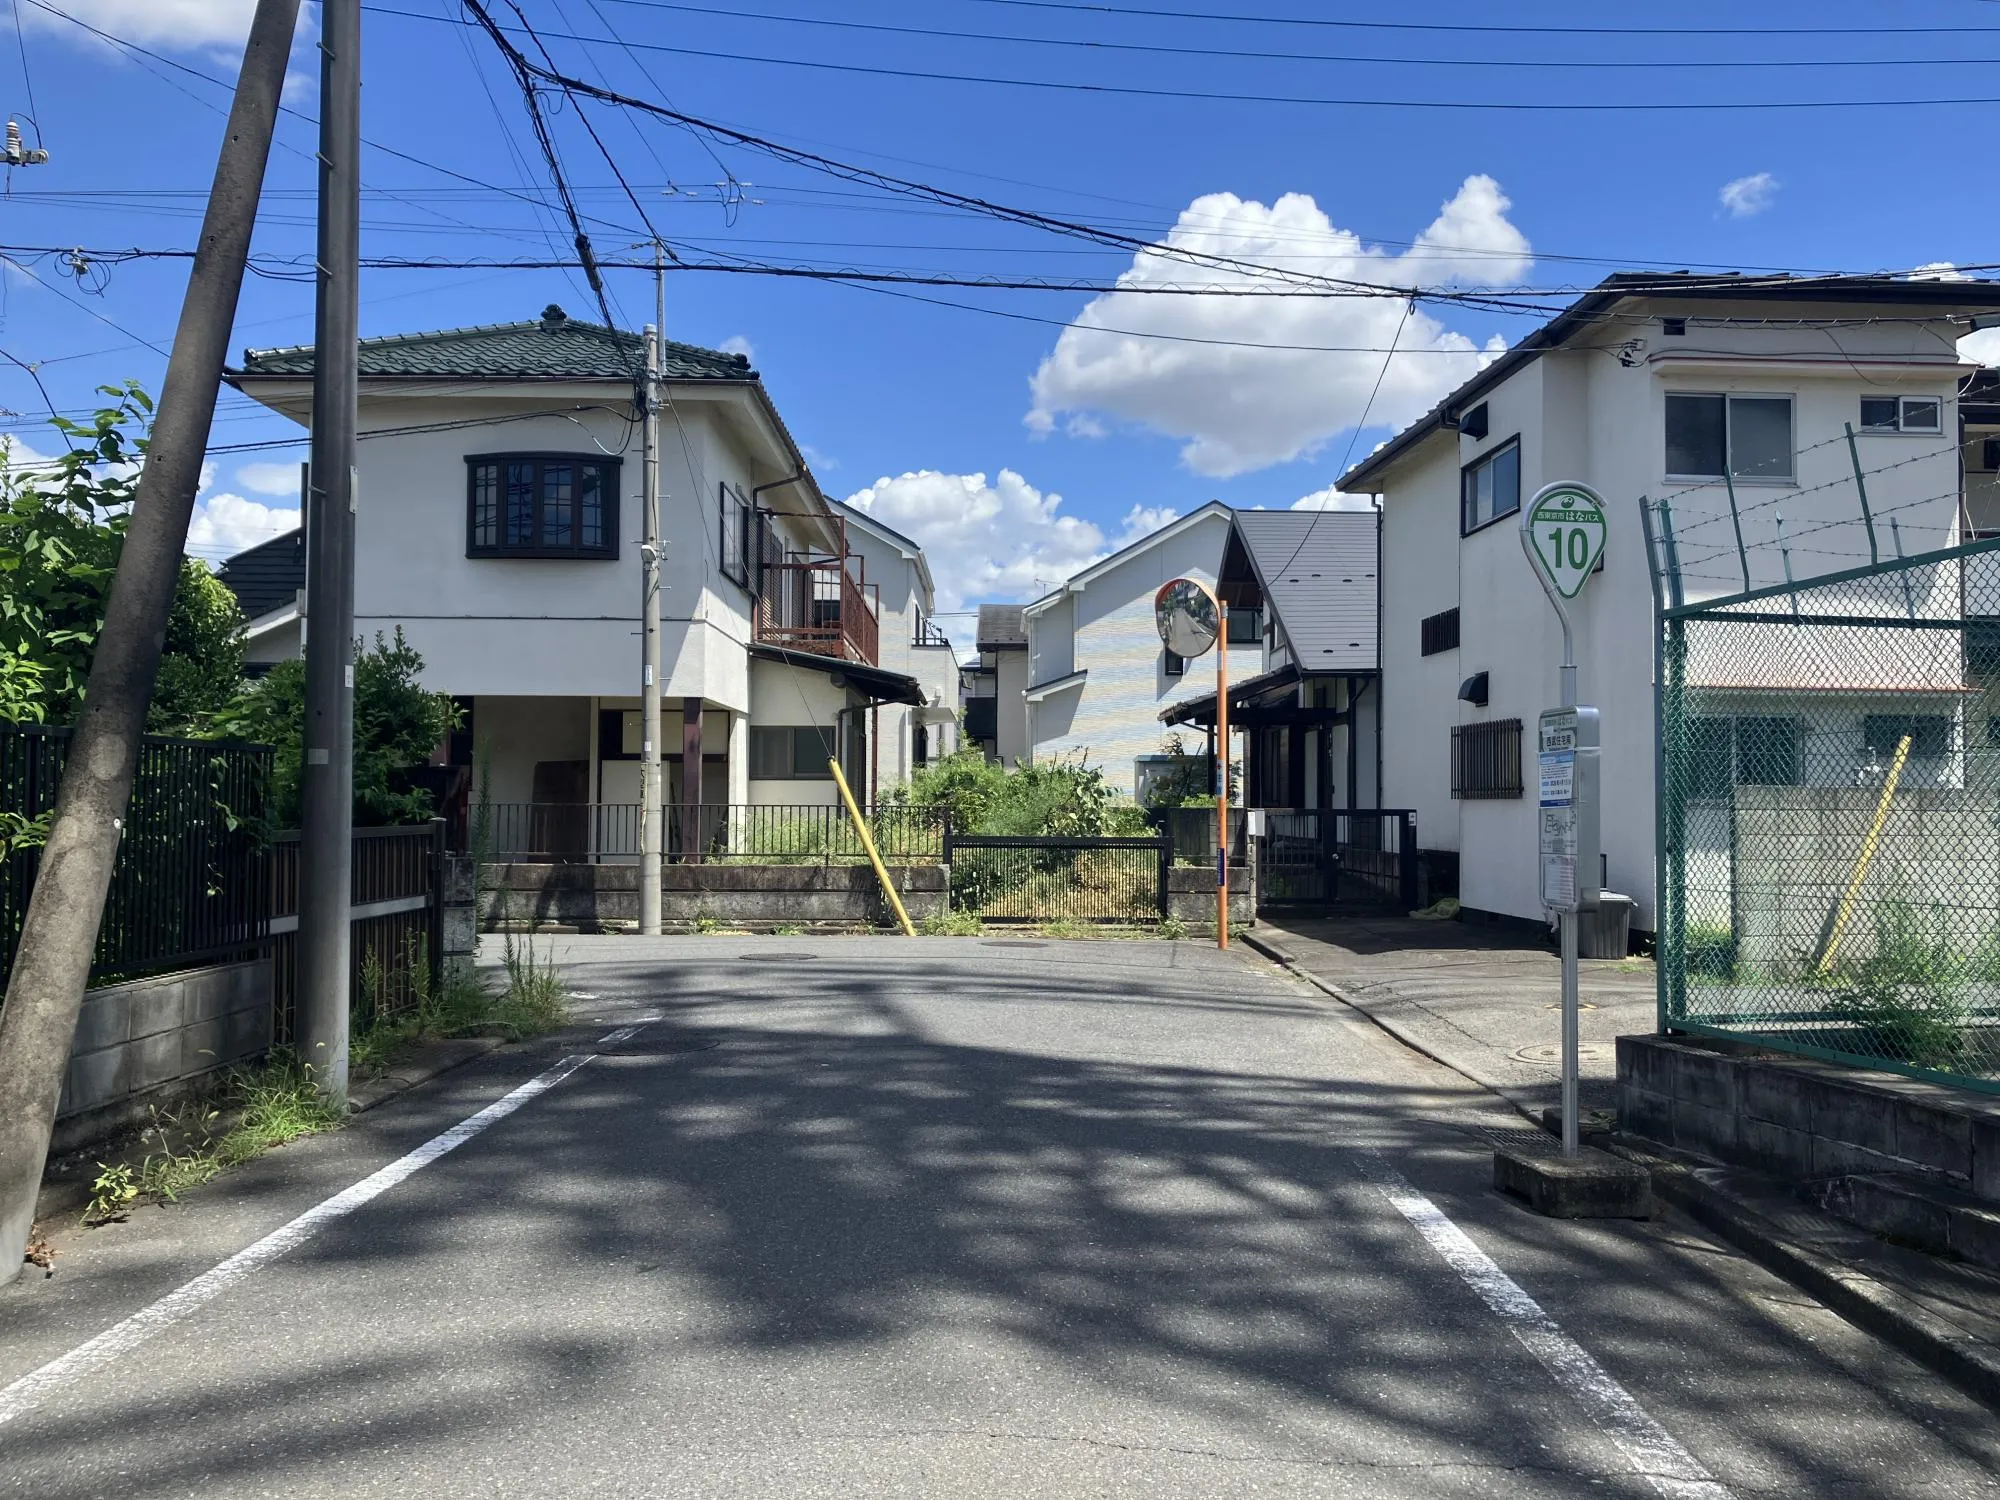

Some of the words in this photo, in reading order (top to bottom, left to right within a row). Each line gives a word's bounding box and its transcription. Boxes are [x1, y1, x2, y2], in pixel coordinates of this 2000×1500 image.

[1537, 512, 1599, 521] 西東京市はなバス
[1549, 528, 1588, 569] 10
